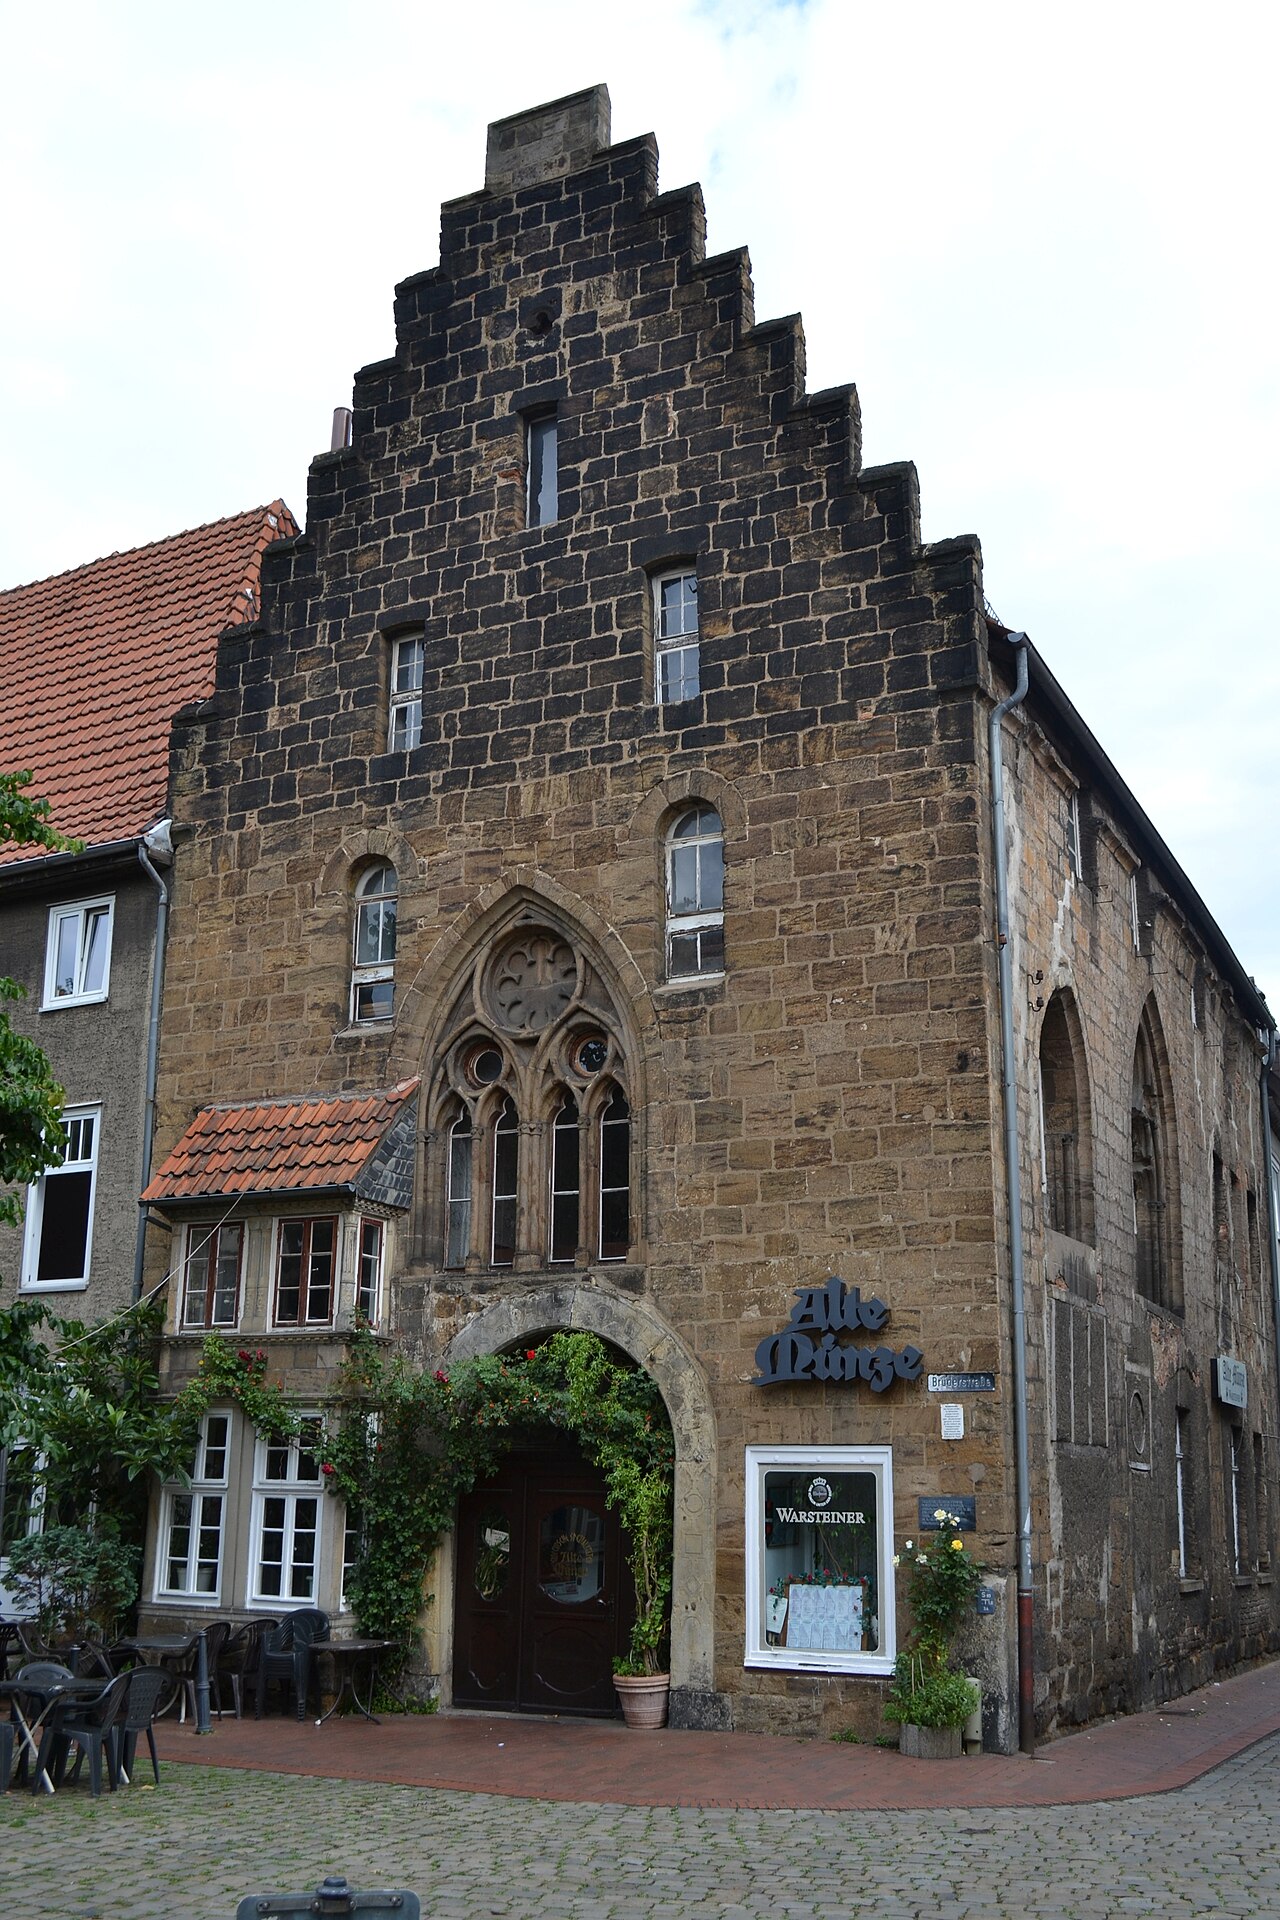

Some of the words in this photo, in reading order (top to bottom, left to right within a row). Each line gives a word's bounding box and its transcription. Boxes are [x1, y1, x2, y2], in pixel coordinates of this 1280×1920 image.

[783, 1276, 888, 1333] Alte
[932, 1376, 991, 1388] Brüderstraße
[776, 1508, 866, 1524] WARSTEINER
